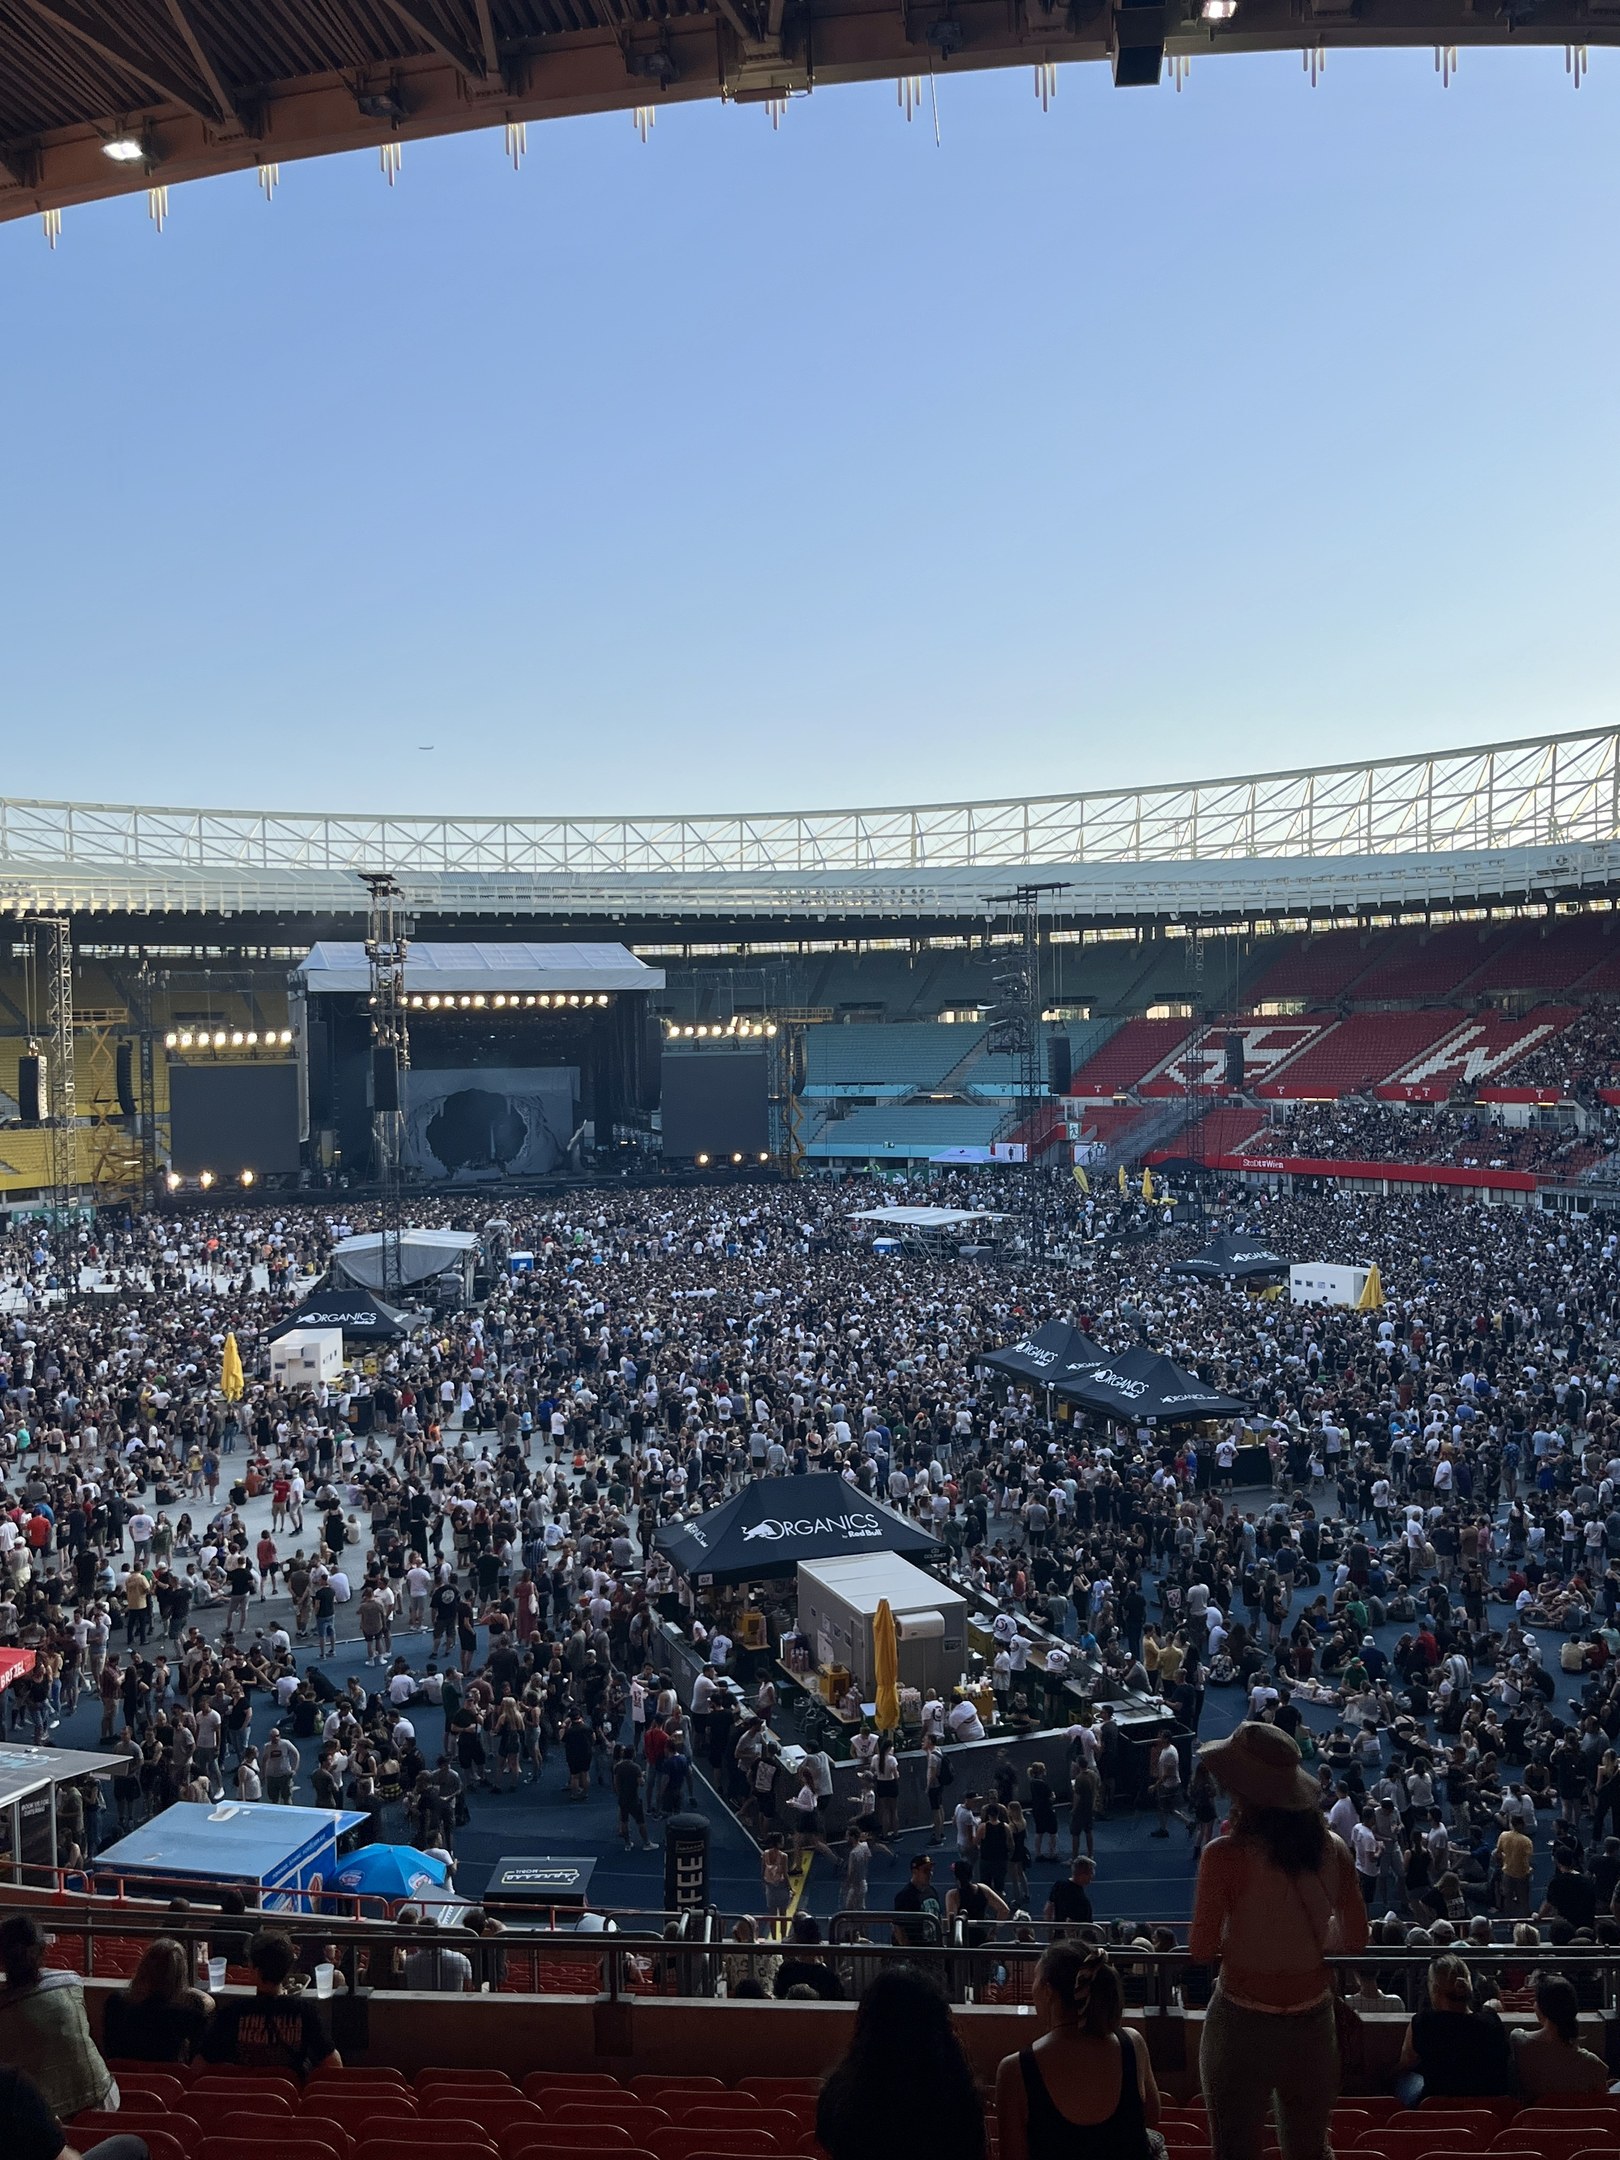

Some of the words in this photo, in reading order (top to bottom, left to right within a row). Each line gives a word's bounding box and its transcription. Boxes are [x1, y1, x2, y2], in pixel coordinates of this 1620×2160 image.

[308, 1312, 377, 1324] ORGANICS
[1095, 1369, 1150, 1395] ORGANICS
[762, 1513, 879, 1540] ORGANICS
[848, 1529, 866, 1538] Red
[866, 1528, 882, 1537] Bull
